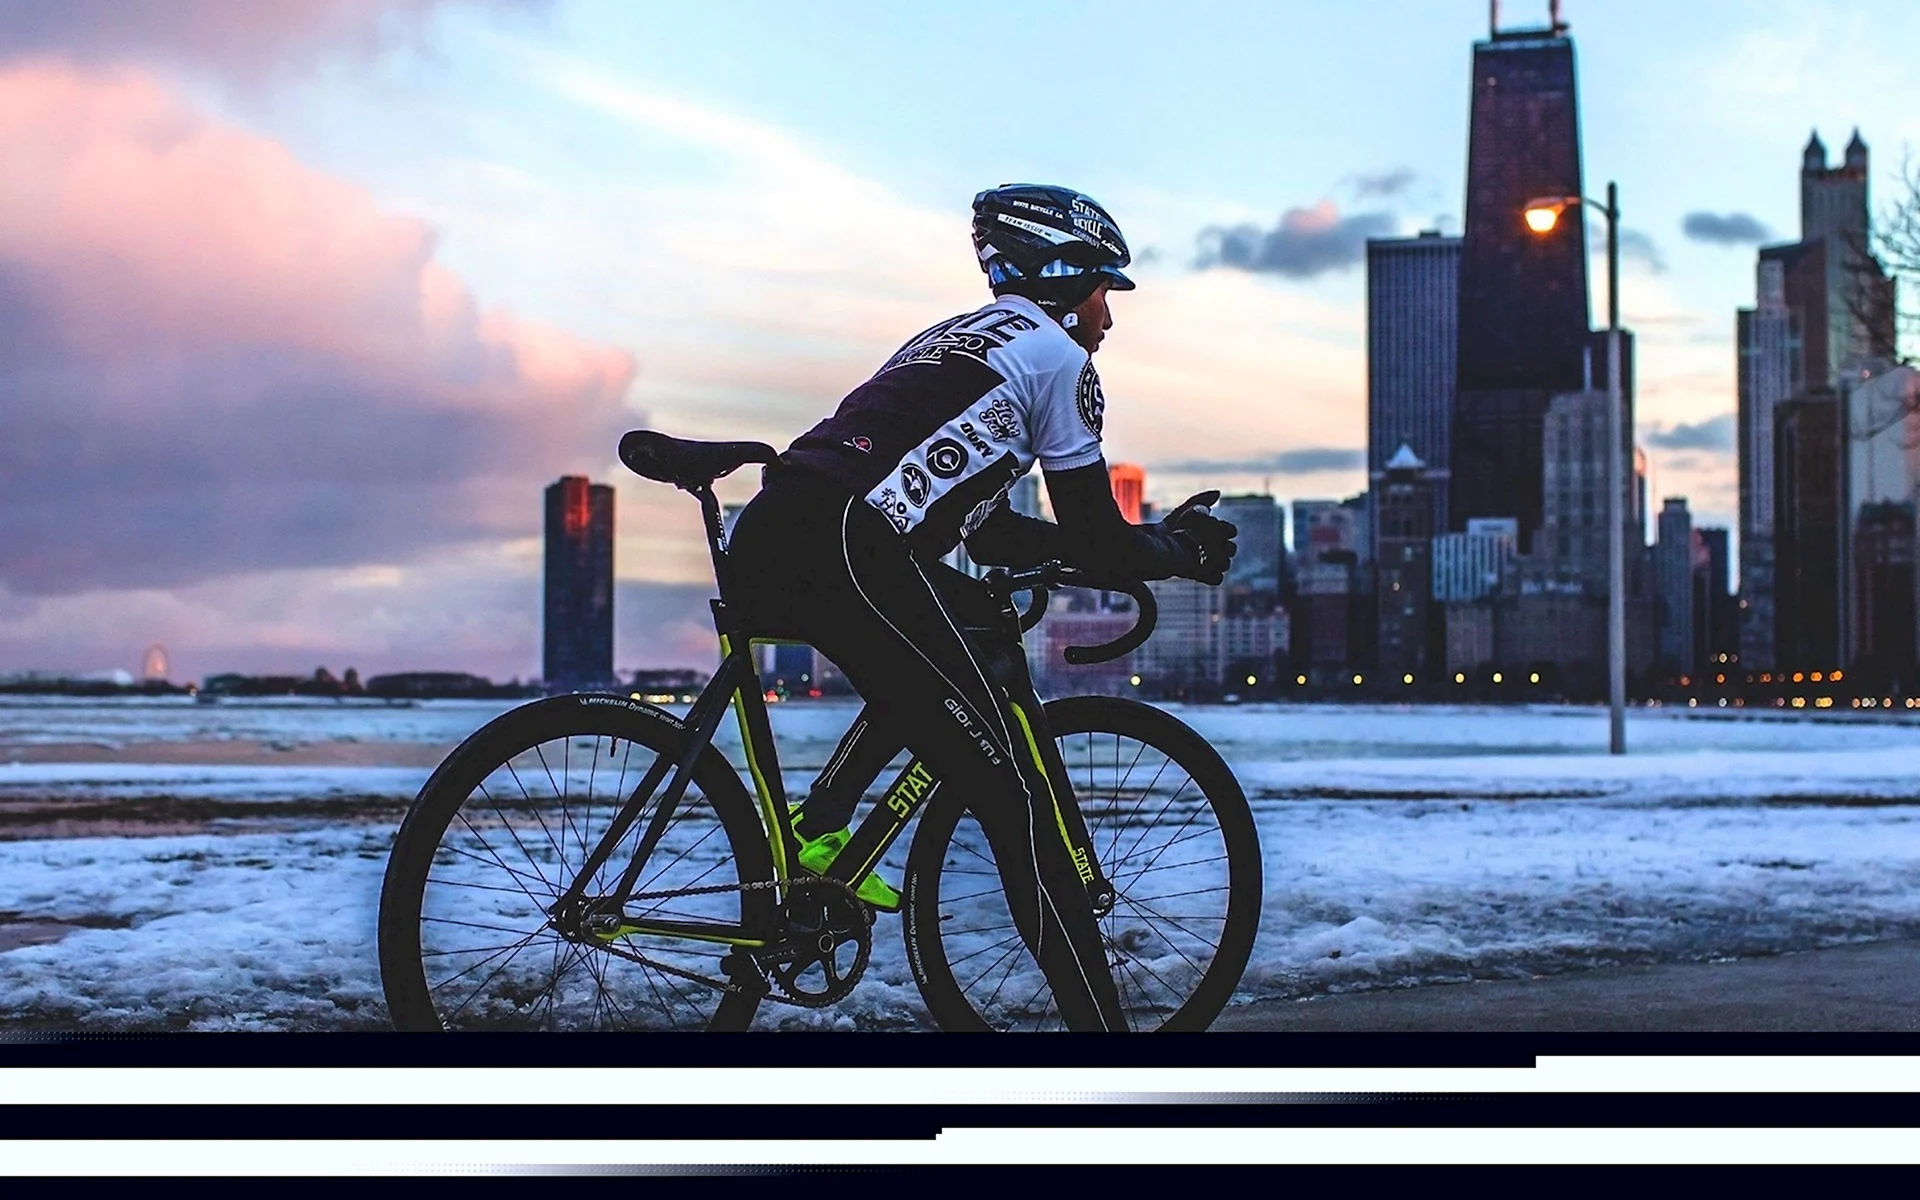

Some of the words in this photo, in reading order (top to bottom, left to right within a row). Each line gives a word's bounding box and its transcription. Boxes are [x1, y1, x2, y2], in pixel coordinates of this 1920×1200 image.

[1072, 199, 1101, 220] STATE
[1004, 216, 1022, 226] TEAM
[1023, 222, 1043, 234] ISSUE
[588, 697, 628, 708] MICHELIN
[628, 702, 659, 718] Dynamic
[1073, 846, 1095, 885] STATE
